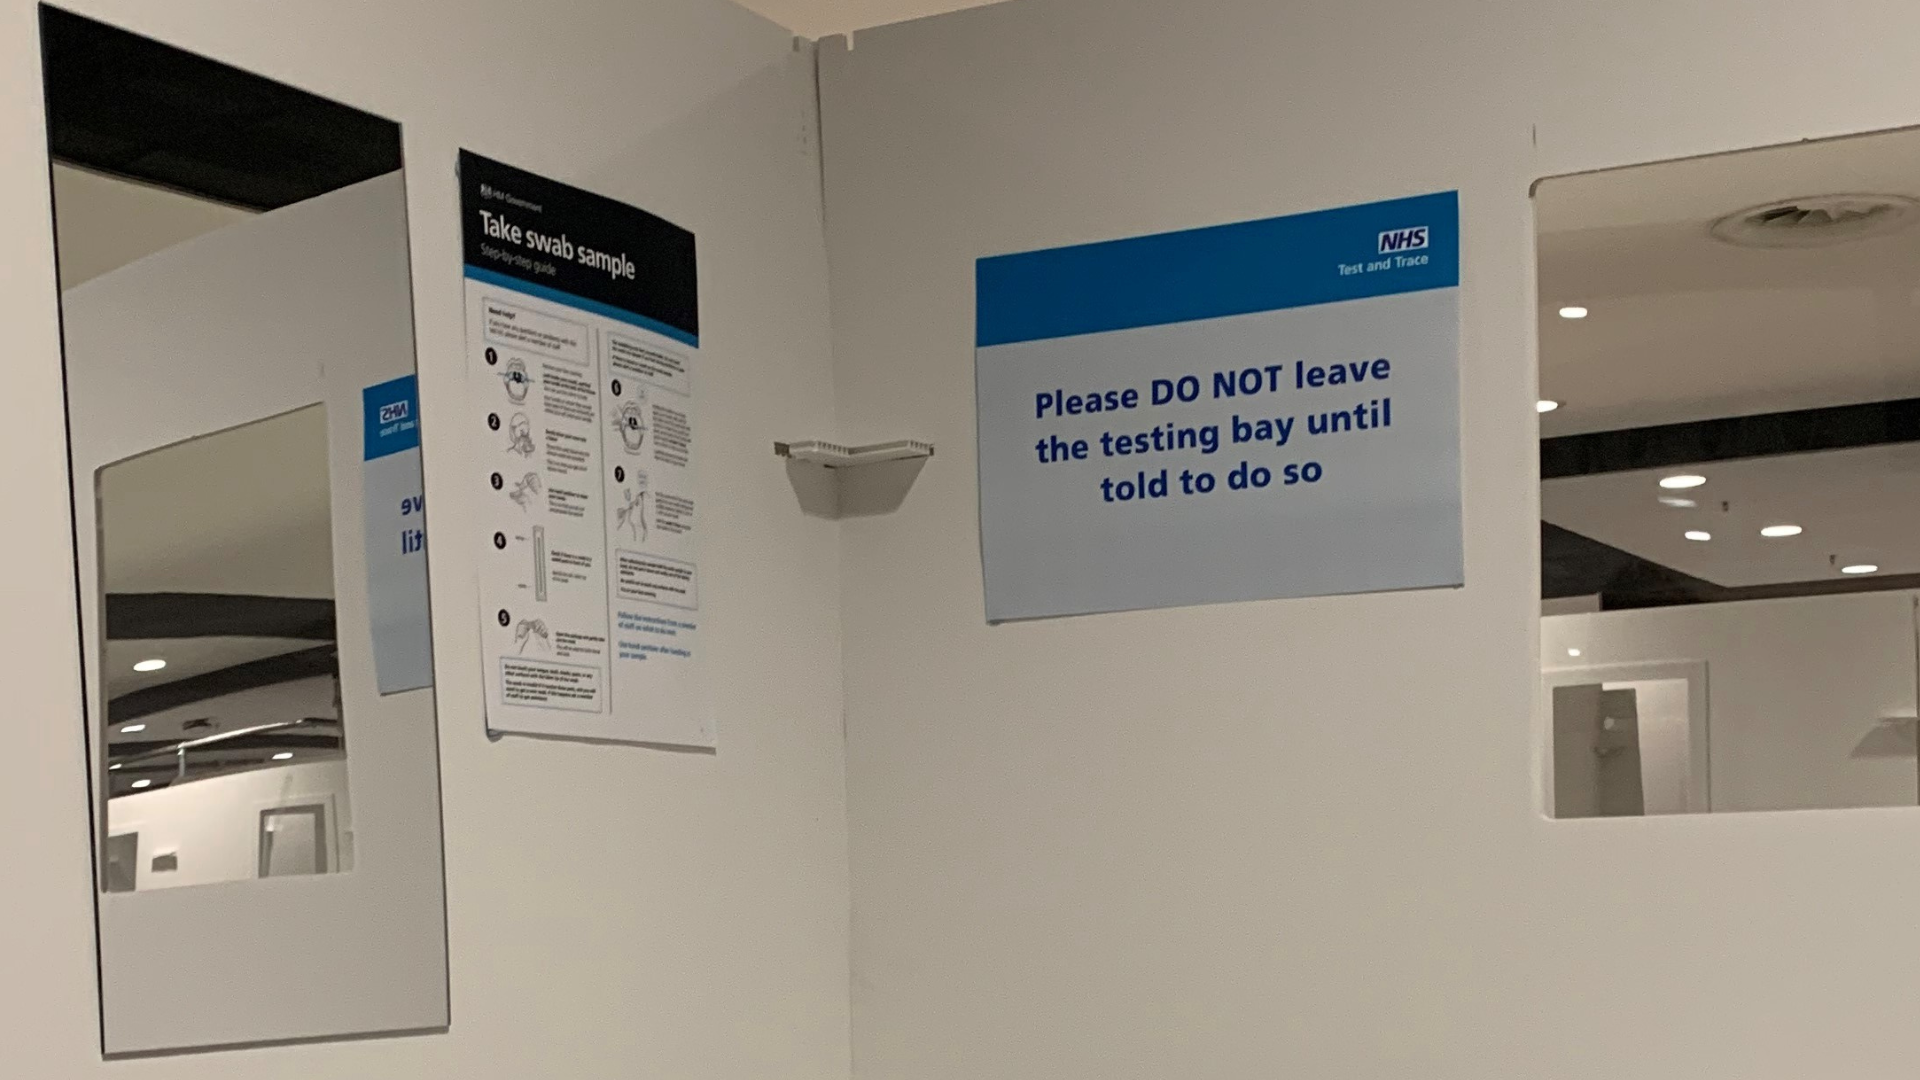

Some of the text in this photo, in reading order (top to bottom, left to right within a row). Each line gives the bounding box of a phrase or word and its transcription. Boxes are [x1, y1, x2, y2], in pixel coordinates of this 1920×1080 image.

[479, 209, 636, 280] Take swab sample
[480, 243, 557, 277] Step-by-step guide
[1380, 228, 1426, 252] NHS
[1337, 255, 1429, 276] Test and Trace
[1036, 358, 1391, 419] Please DO NOT leave
[1035, 397, 1391, 463] the testing bay until
[1100, 460, 1323, 502] told to do so
